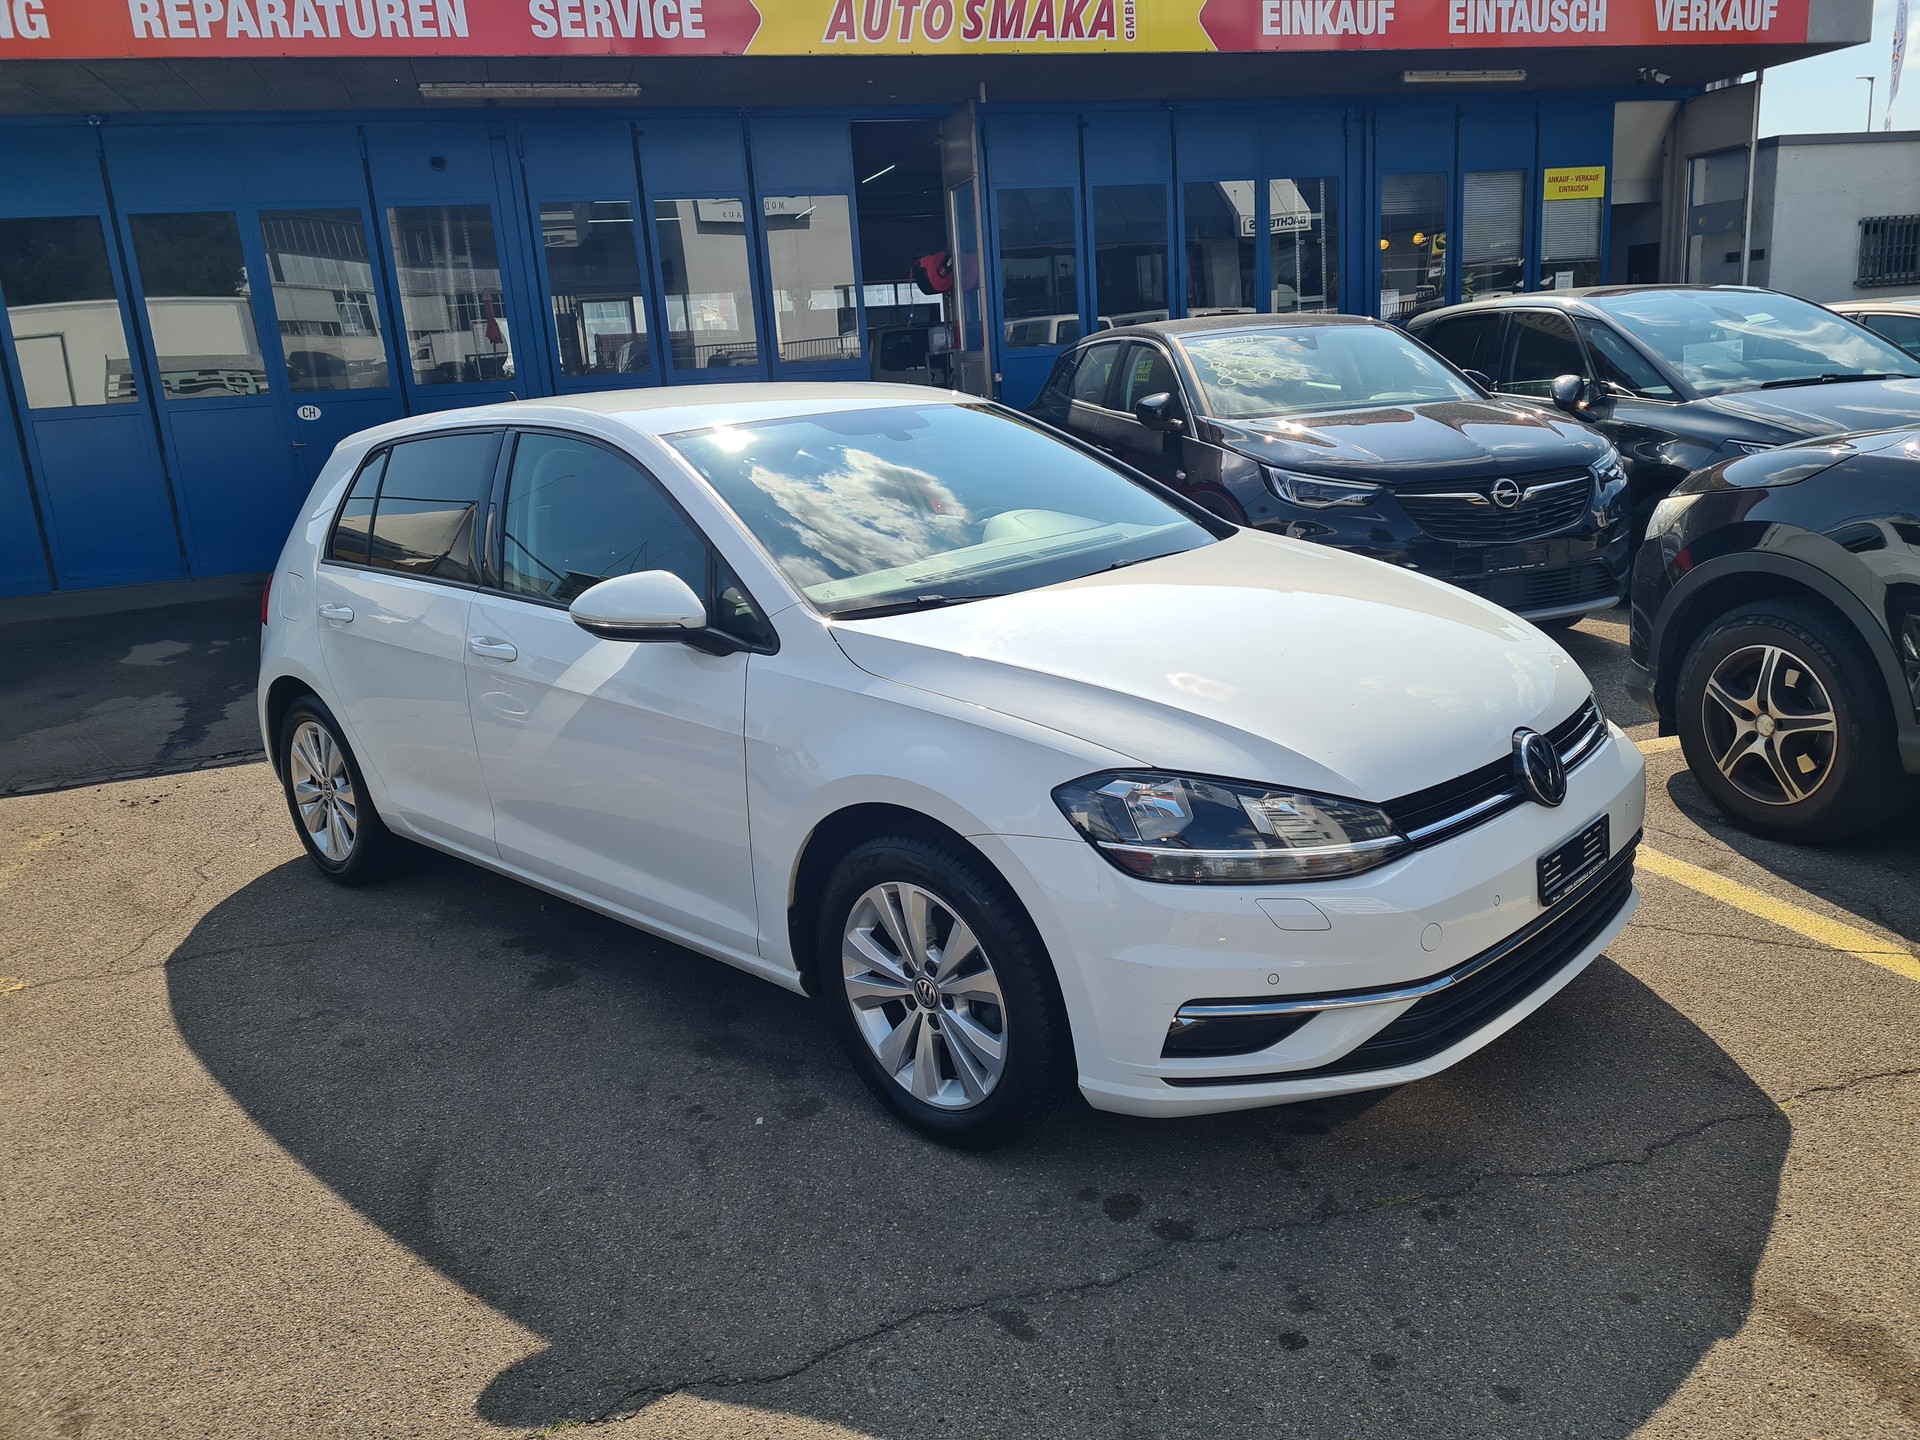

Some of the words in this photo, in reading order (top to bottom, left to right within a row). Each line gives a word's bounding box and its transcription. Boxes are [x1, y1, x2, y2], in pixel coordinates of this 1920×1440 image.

[128, 0, 470, 38] REPARATUREN
[529, 0, 706, 38] SERVICE
[822, 0, 954, 43] AUTO
[960, 0, 1118, 42] SMAKA
[1262, 0, 1396, 35] EINKAUF
[1448, 0, 1608, 34] EINTAUSCH
[1654, 0, 1779, 32] VERKAUF
[1547, 175, 1570, 184] ANKAUF
[1575, 173, 1600, 182] VERKAUF
[1558, 184, 1589, 193] EINTAUSCH
[302, 406, 316, 419] CH
